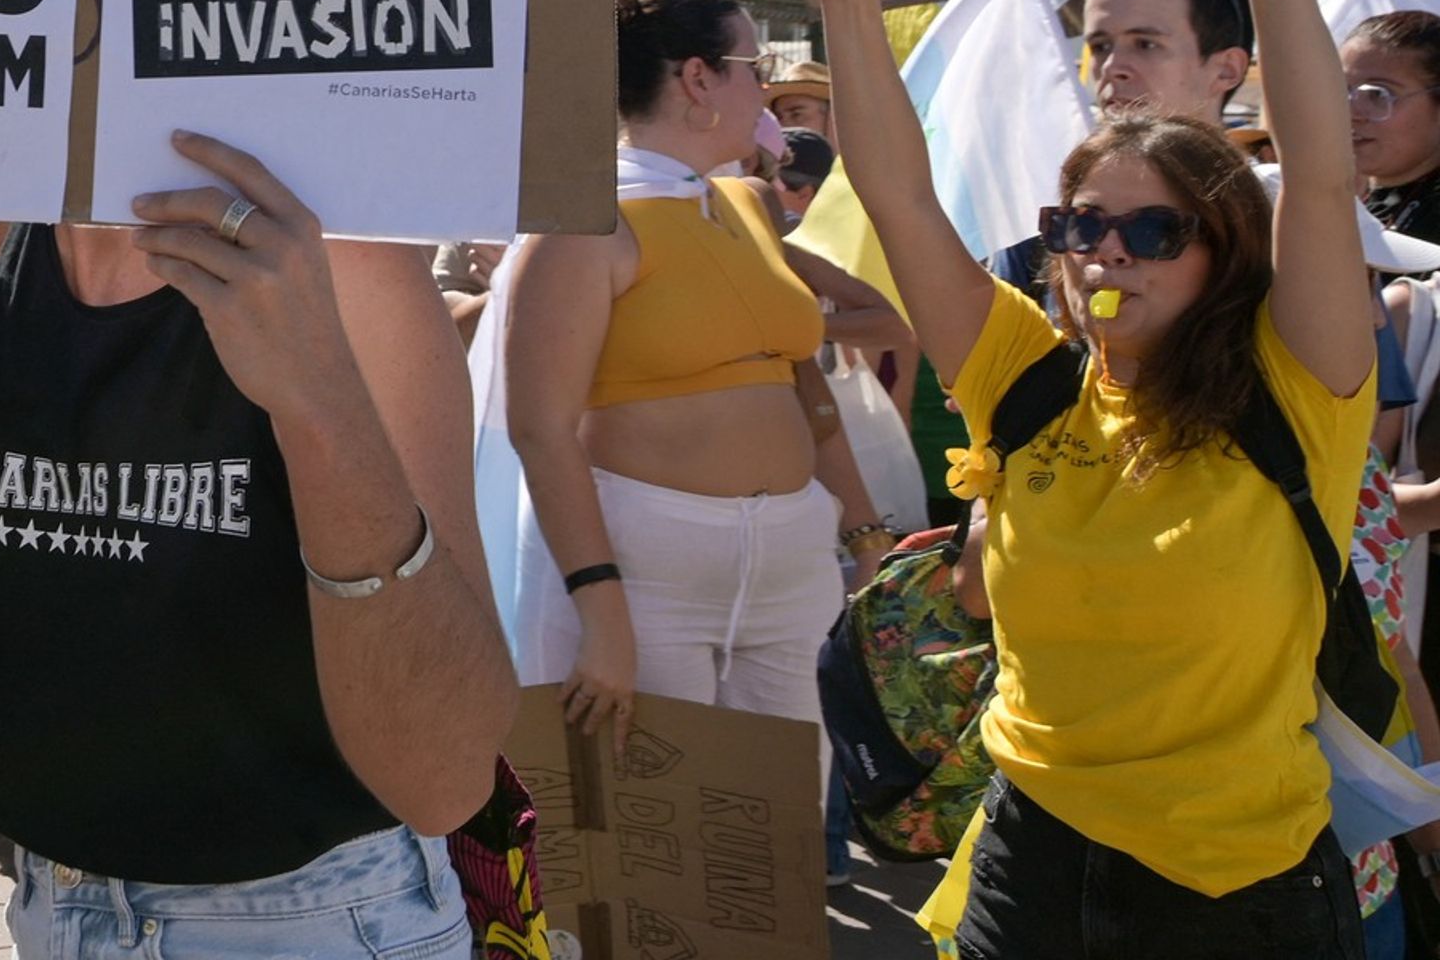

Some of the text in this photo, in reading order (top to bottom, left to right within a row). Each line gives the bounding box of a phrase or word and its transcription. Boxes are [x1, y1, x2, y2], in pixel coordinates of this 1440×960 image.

[328, 81, 478, 103] #CanariasSeHarta
[117, 457, 251, 538] LIBRE
[614, 792, 684, 877] DEL
[699, 786, 776, 934] RUINA
